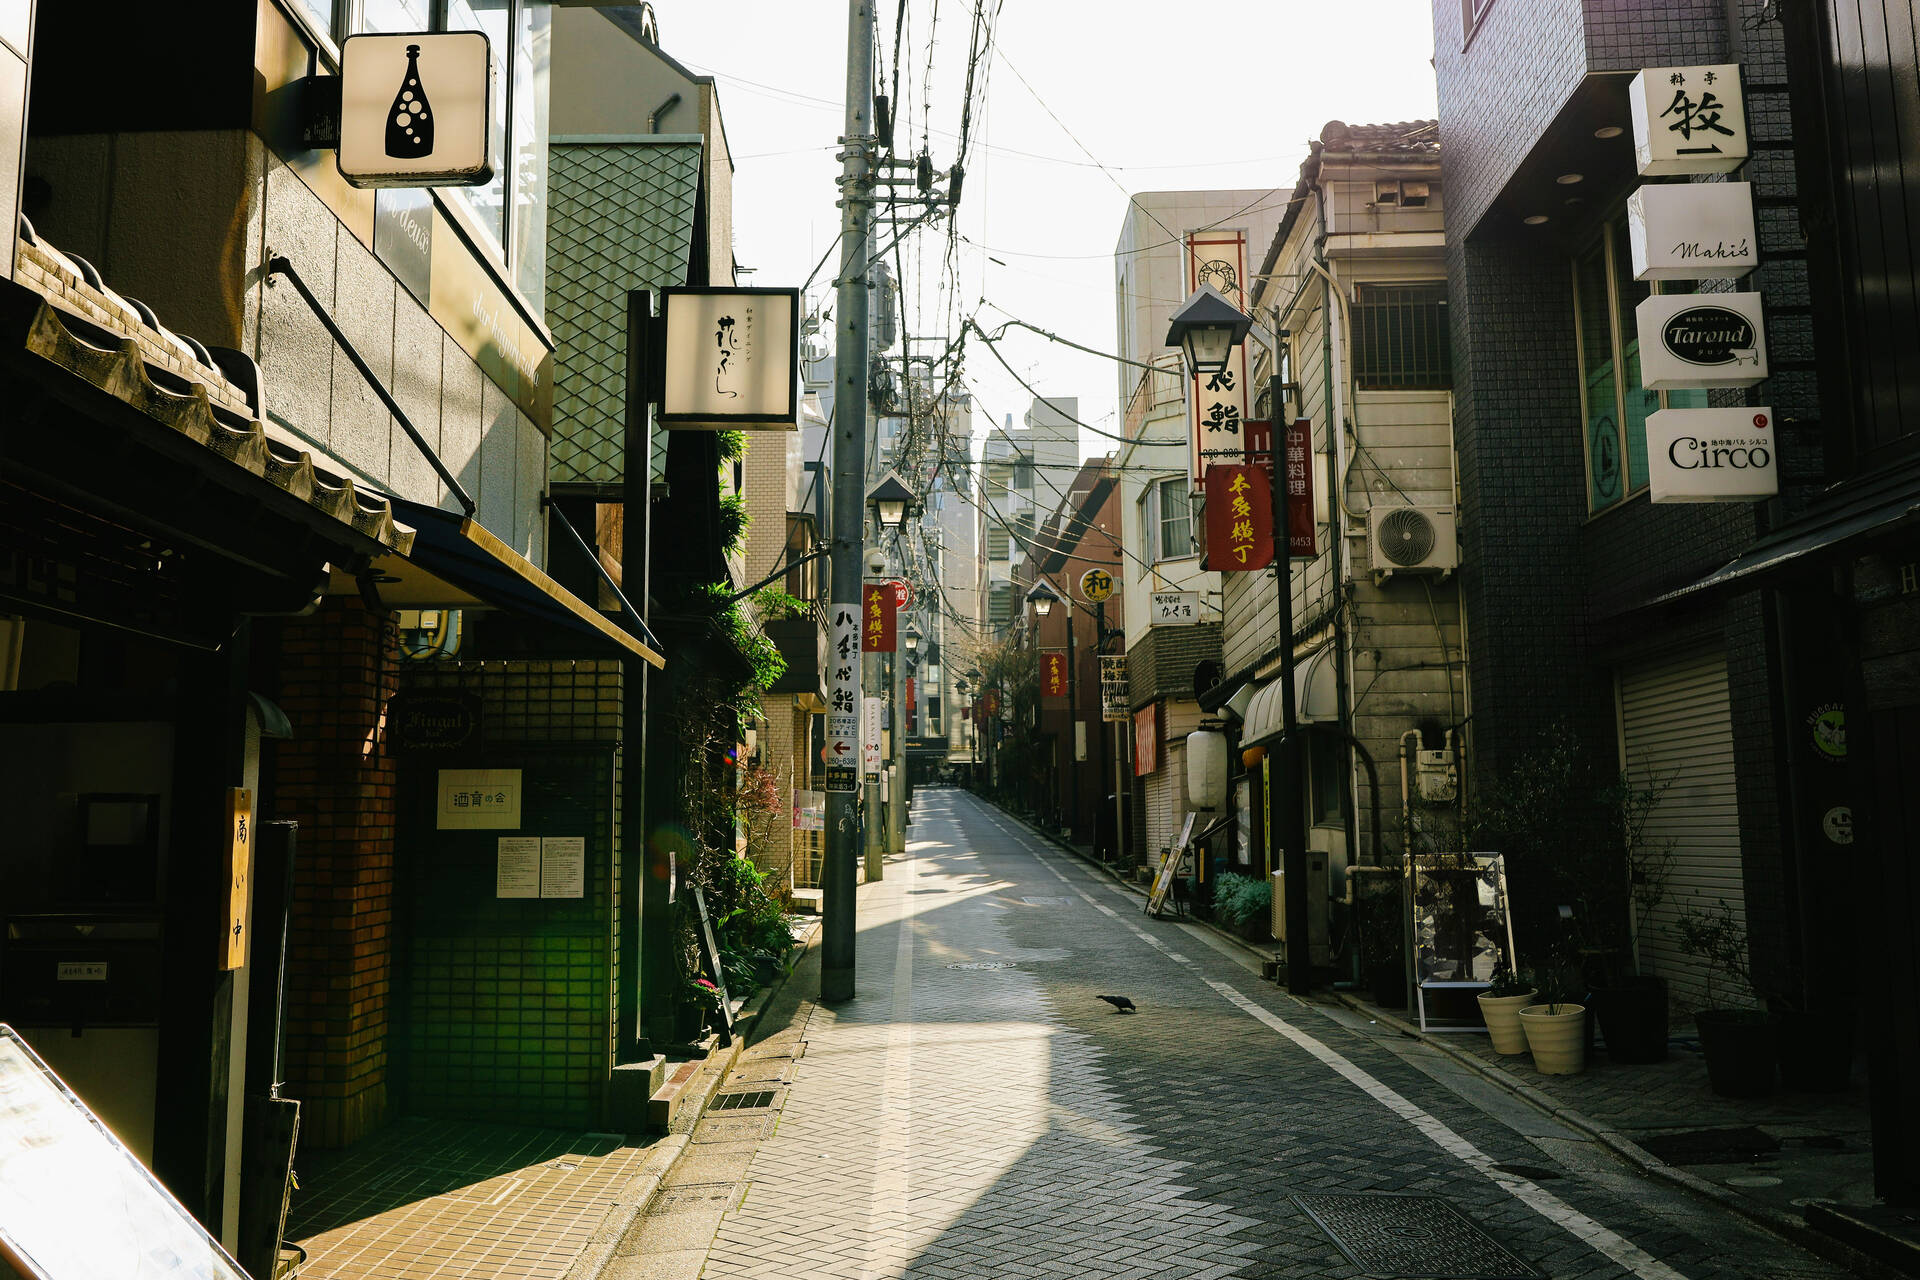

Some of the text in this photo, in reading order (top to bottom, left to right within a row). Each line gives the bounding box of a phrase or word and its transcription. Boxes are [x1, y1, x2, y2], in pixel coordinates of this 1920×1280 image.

[1670, 72, 1718, 86] 料亭
[1660, 90, 1735, 141] 牧
[1671, 239, 1749, 259] Maki's
[1669, 325, 1746, 344] Tarond
[1668, 436, 1770, 470] Circo
[1228, 472, 1255, 564] 本多横丁
[1086, 570, 1111, 593] 和
[868, 590, 883, 648] 本多横丁
[454, 791, 505, 808] 酒育の会
[233, 815, 248, 948] 商い中
